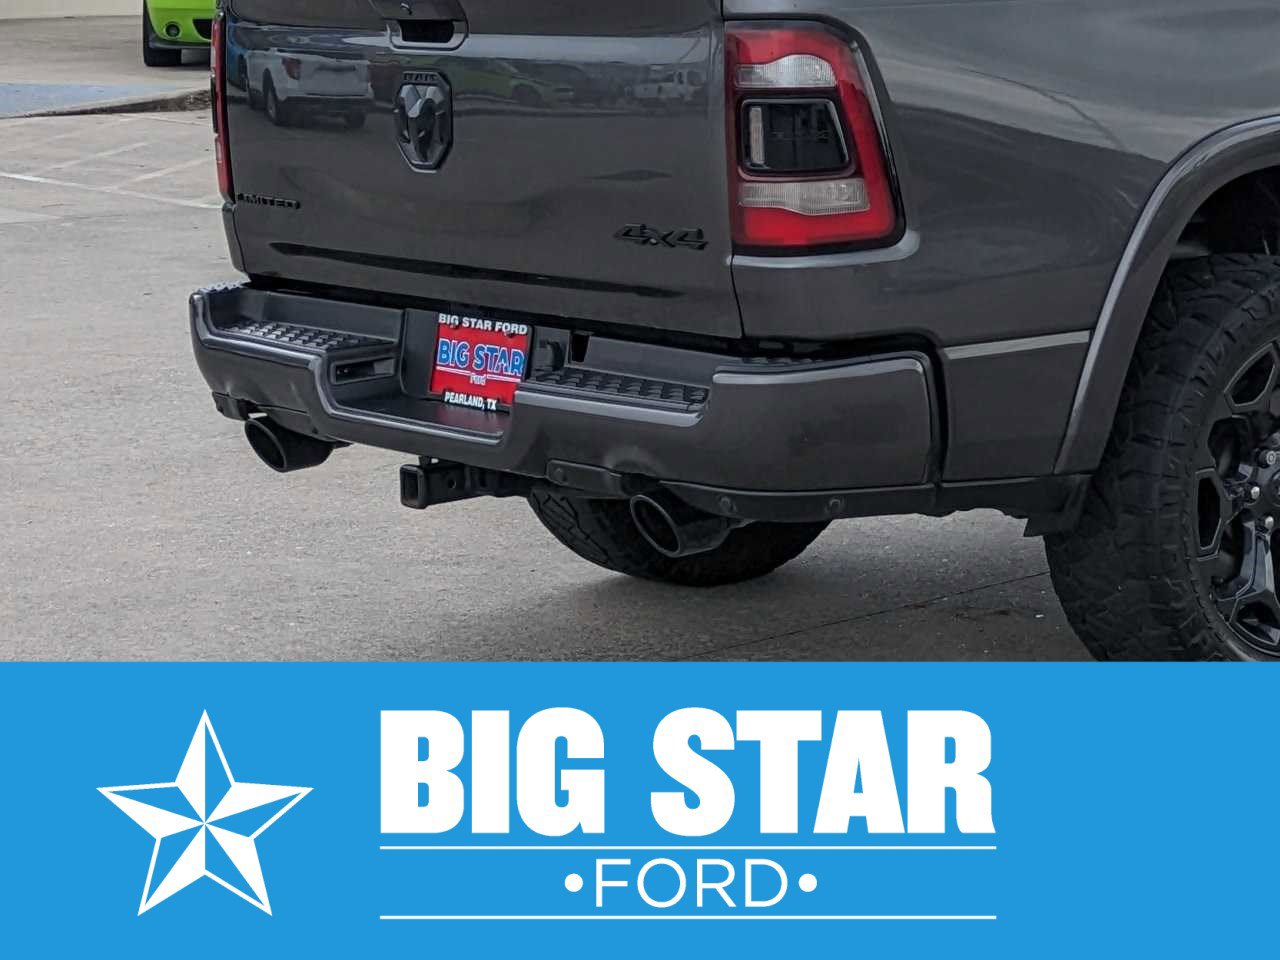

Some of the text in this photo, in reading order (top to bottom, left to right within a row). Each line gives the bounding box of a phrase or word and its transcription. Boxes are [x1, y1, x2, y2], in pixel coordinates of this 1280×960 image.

[438, 312, 528, 336] BIG STAR FORD
[436, 337, 526, 378] BIG STAR
[444, 390, 498, 411] PEARLAND, TX
